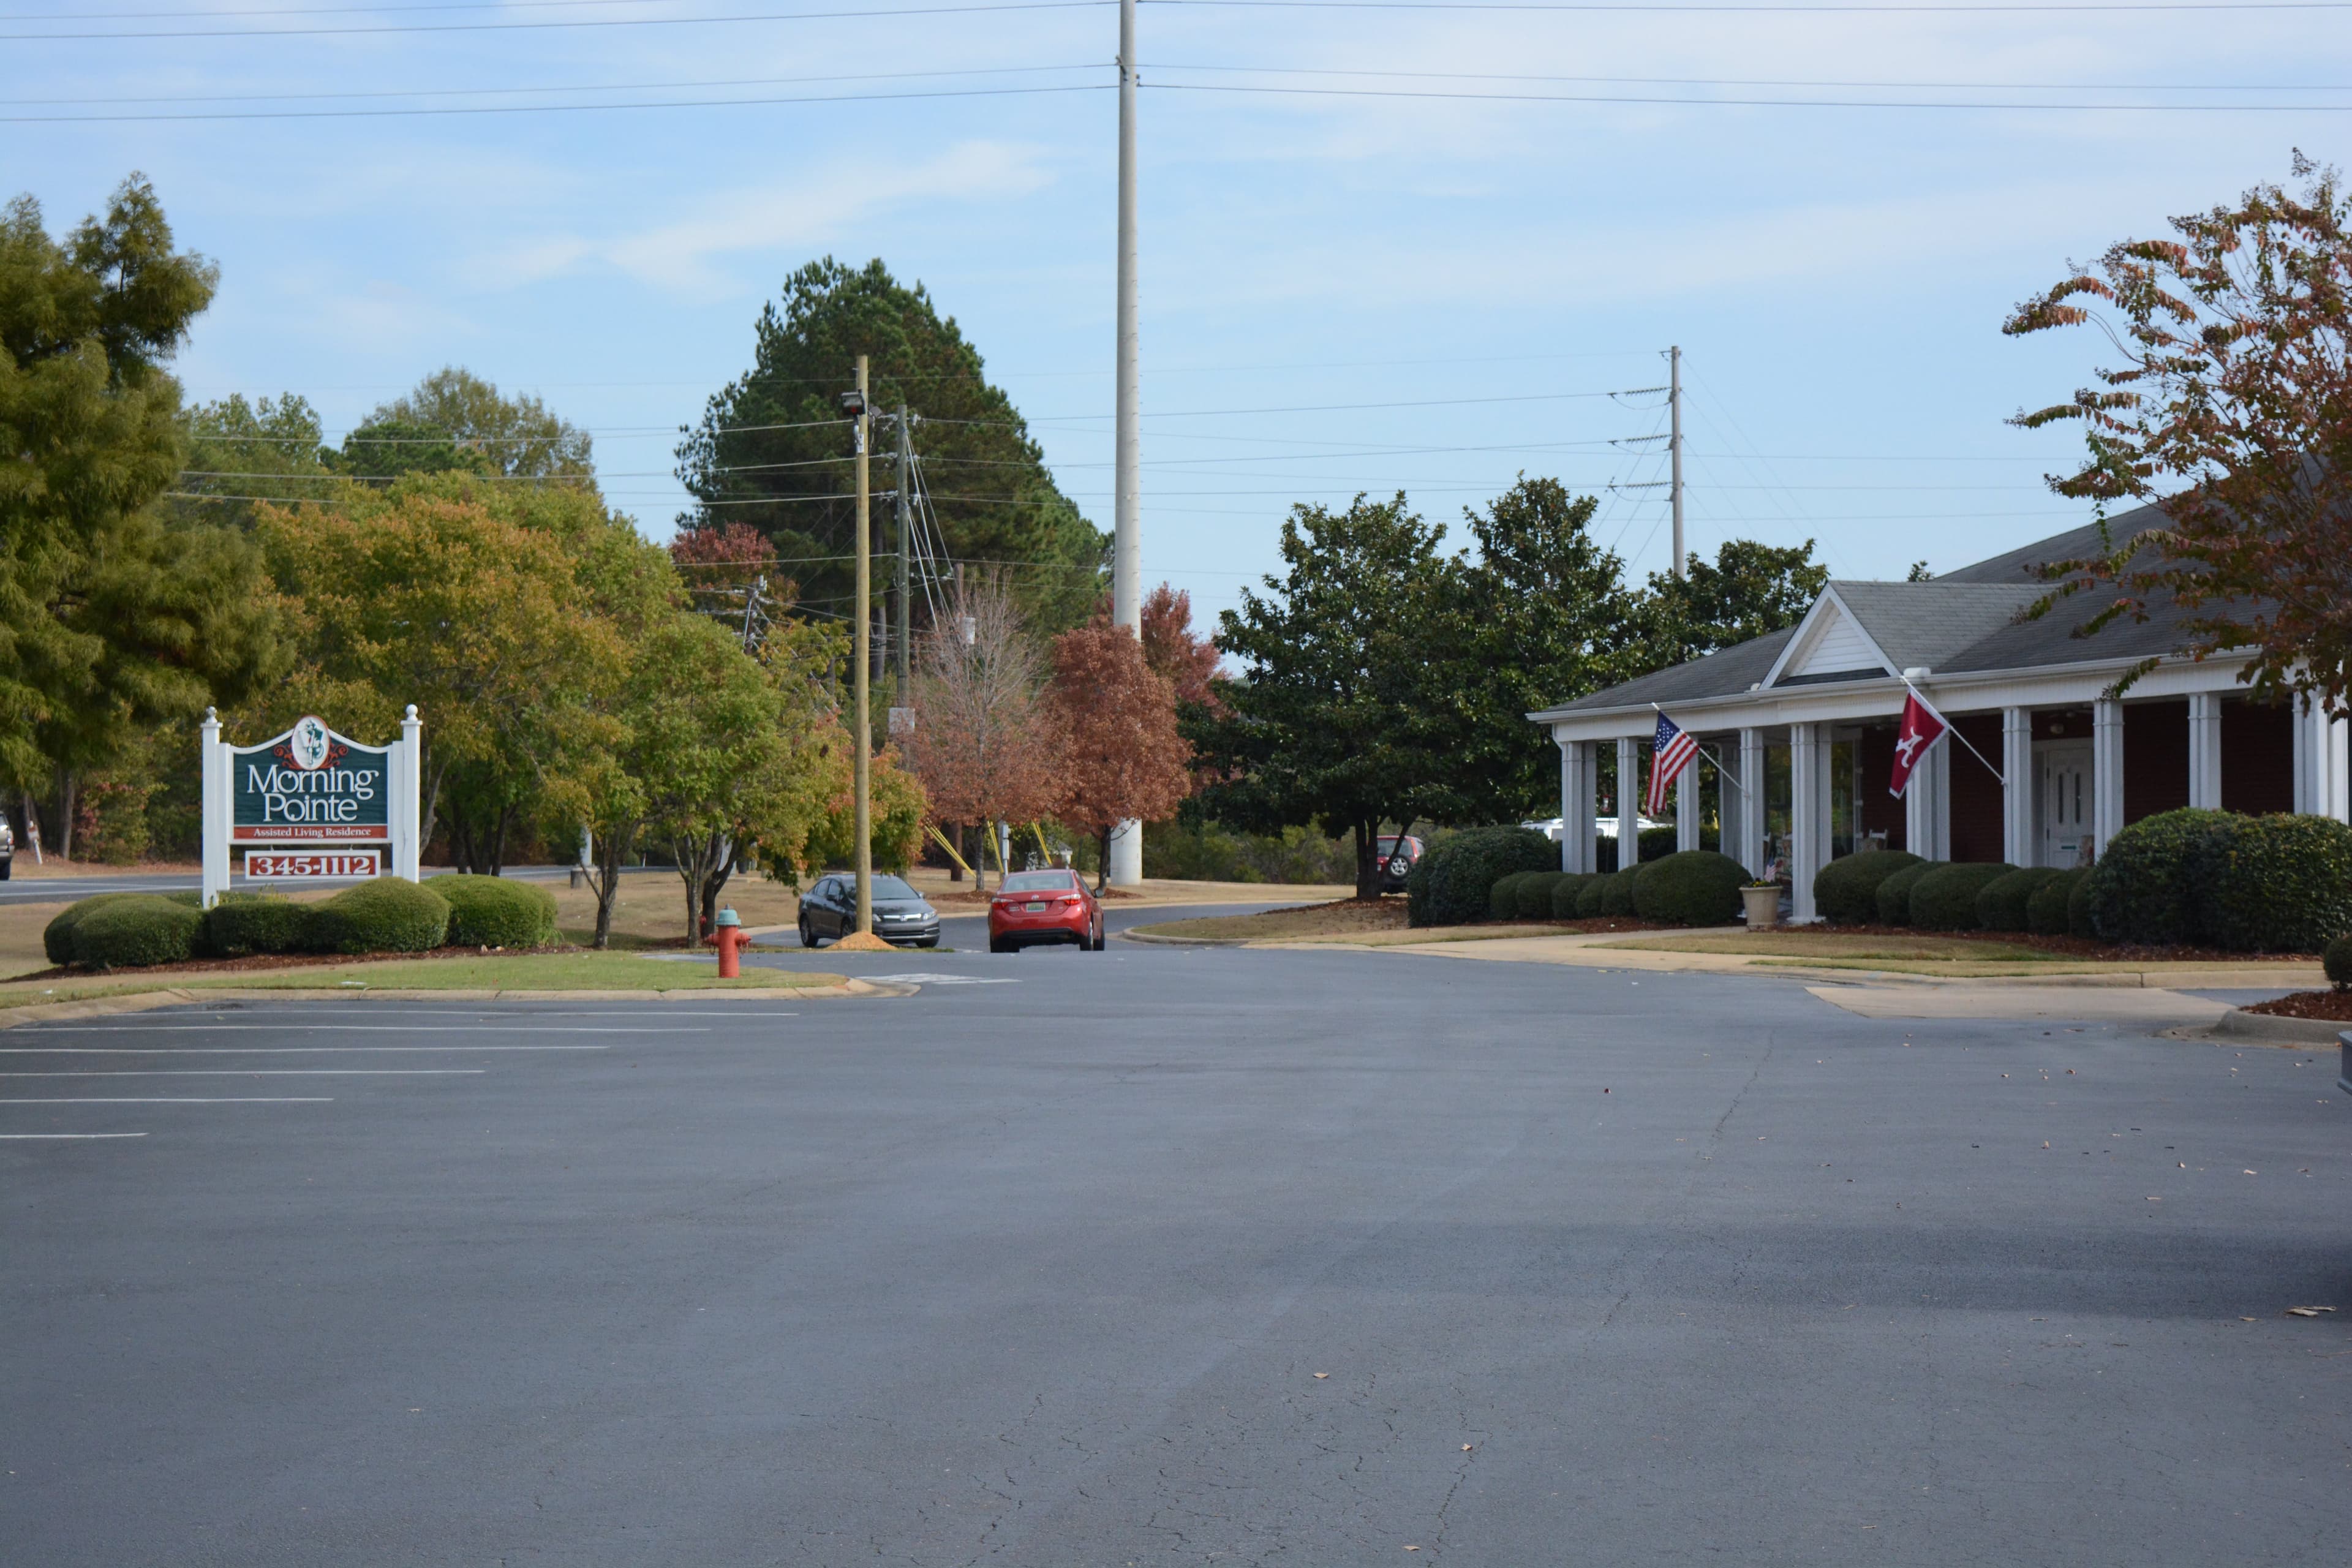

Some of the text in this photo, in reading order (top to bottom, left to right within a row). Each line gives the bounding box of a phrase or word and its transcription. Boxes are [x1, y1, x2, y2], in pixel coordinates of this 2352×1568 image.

[1896, 726, 1923, 767] A
[247, 764, 379, 800] Morning
[263, 793, 358, 822] Pointe
[254, 827, 371, 838] Assisted Living Residence
[256, 857, 371, 875] 345-1112
